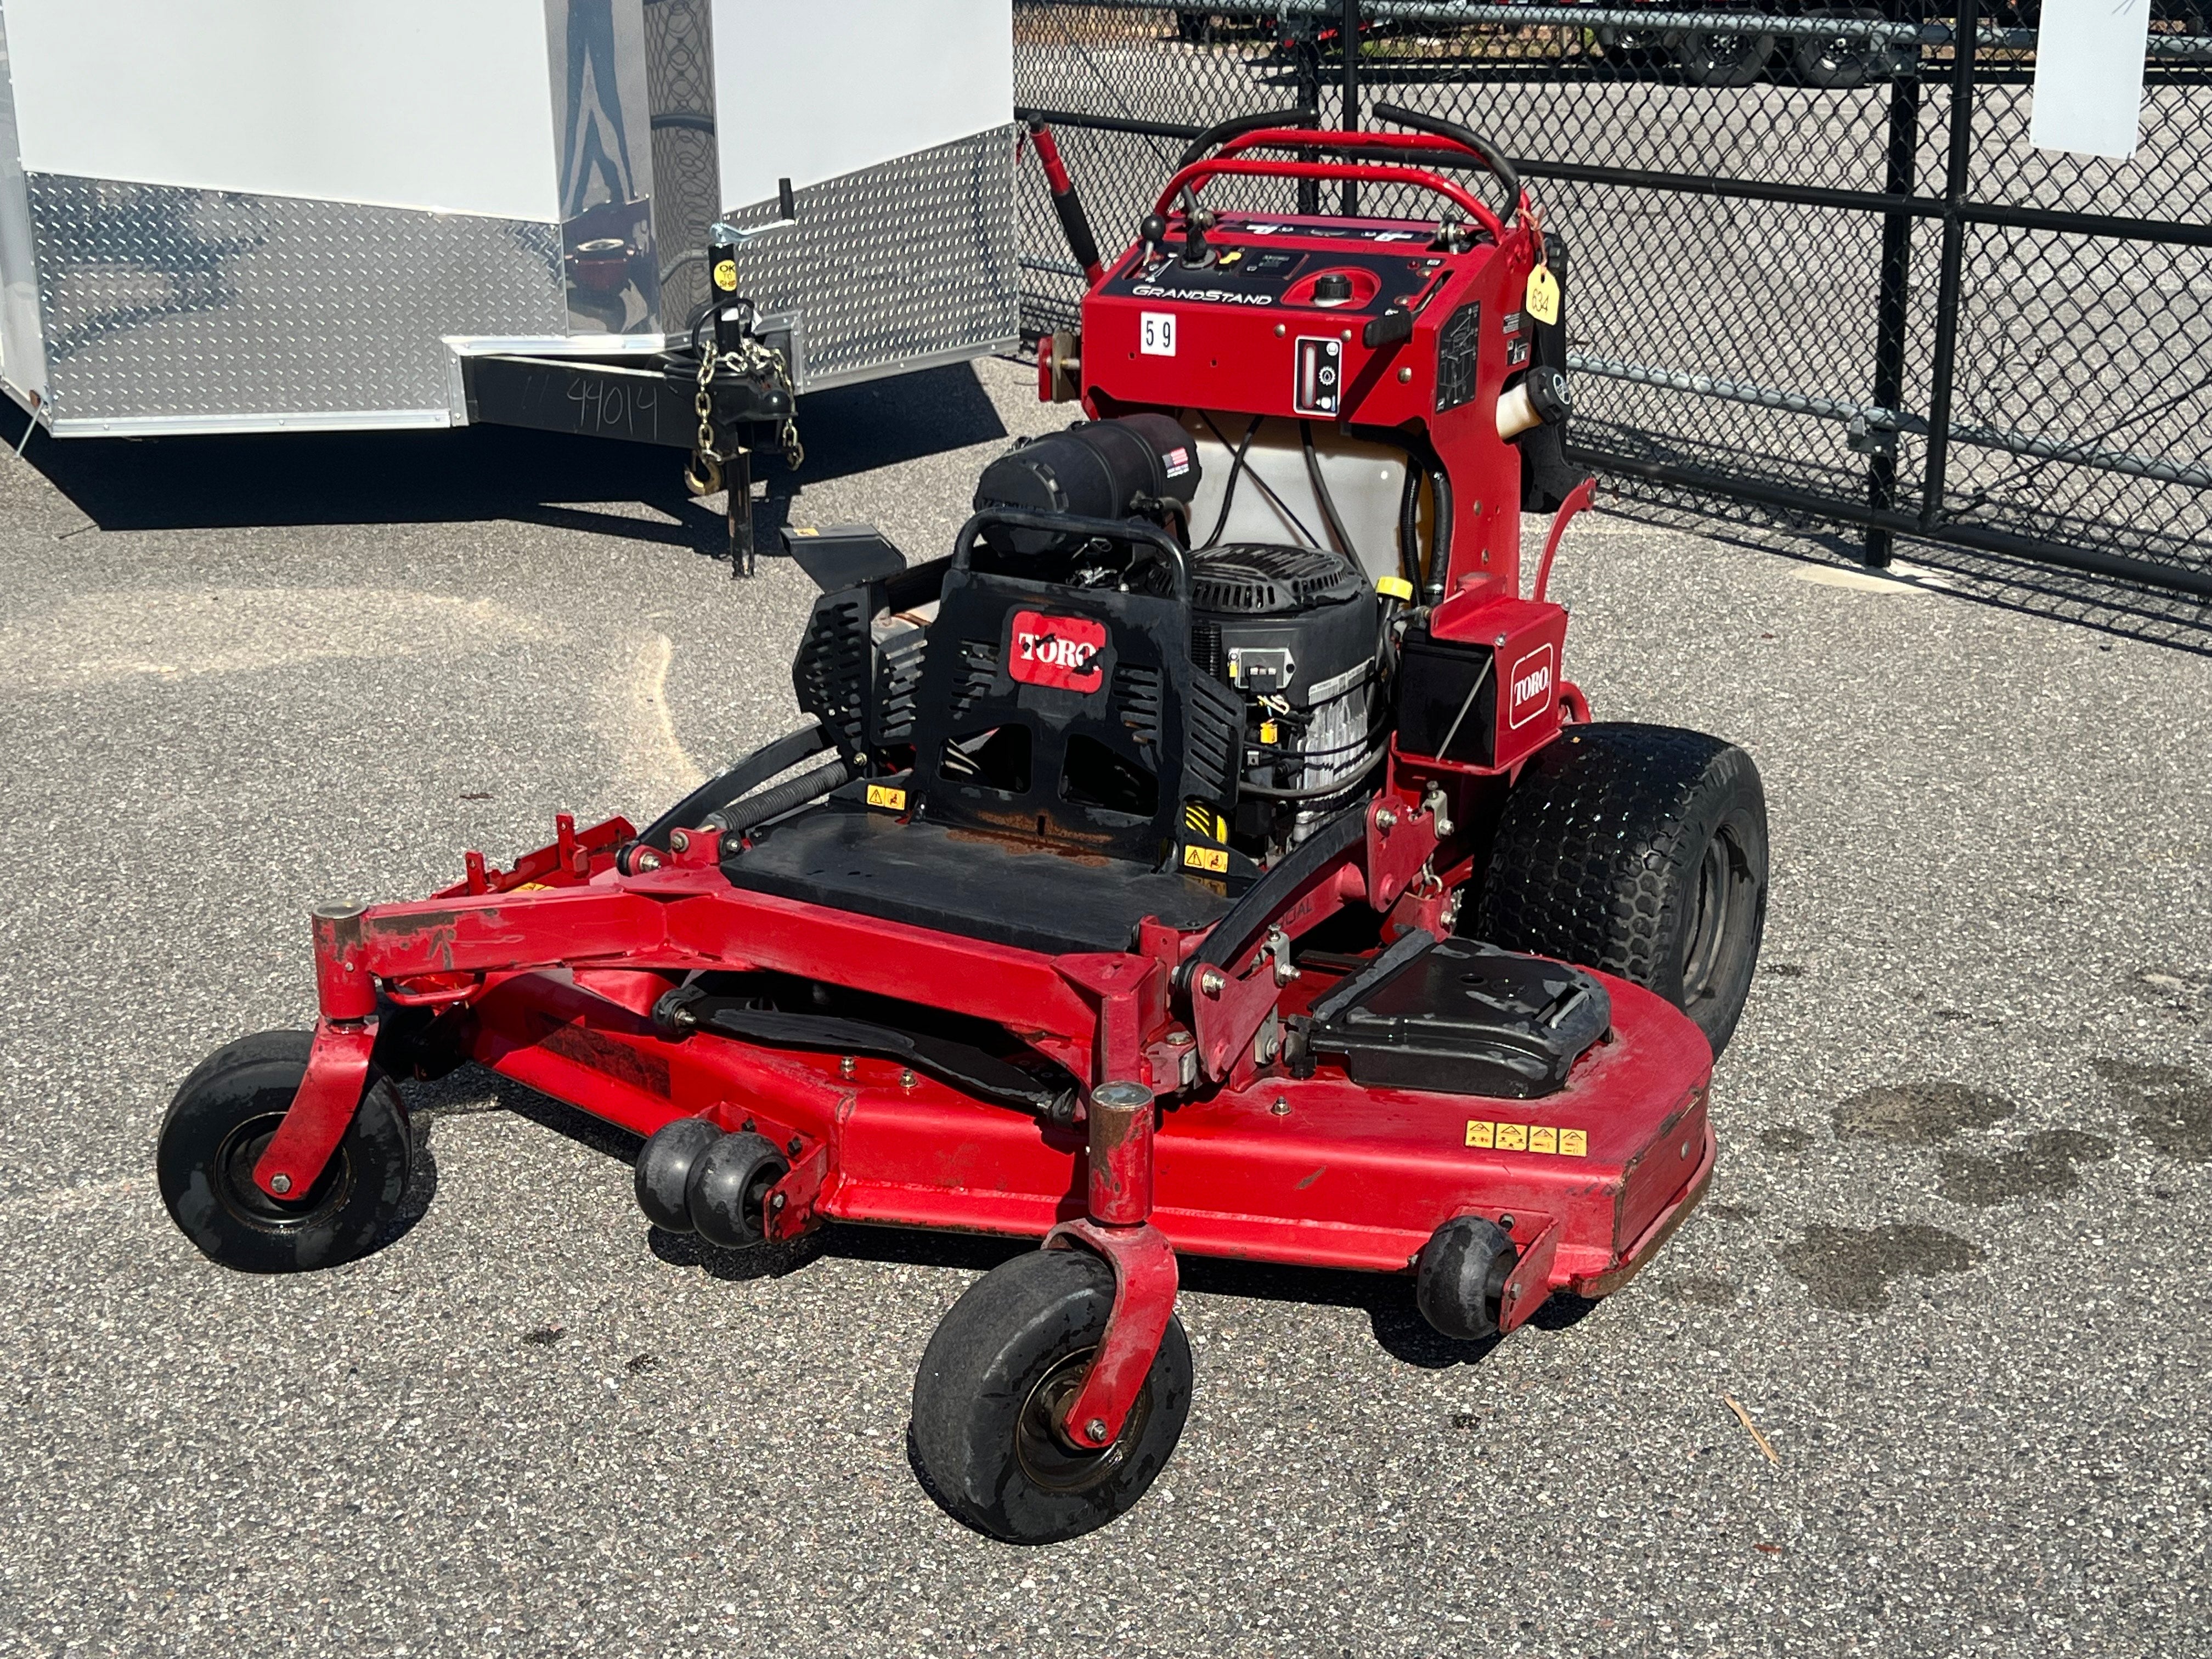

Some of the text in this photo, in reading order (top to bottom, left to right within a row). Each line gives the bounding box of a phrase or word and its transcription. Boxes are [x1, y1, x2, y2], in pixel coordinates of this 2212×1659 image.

[719, 264, 736, 273] OK
[1132, 284, 1272, 305] GRANDSTAND
[1532, 287, 1550, 314] 634
[1514, 667, 1549, 707] TORO
